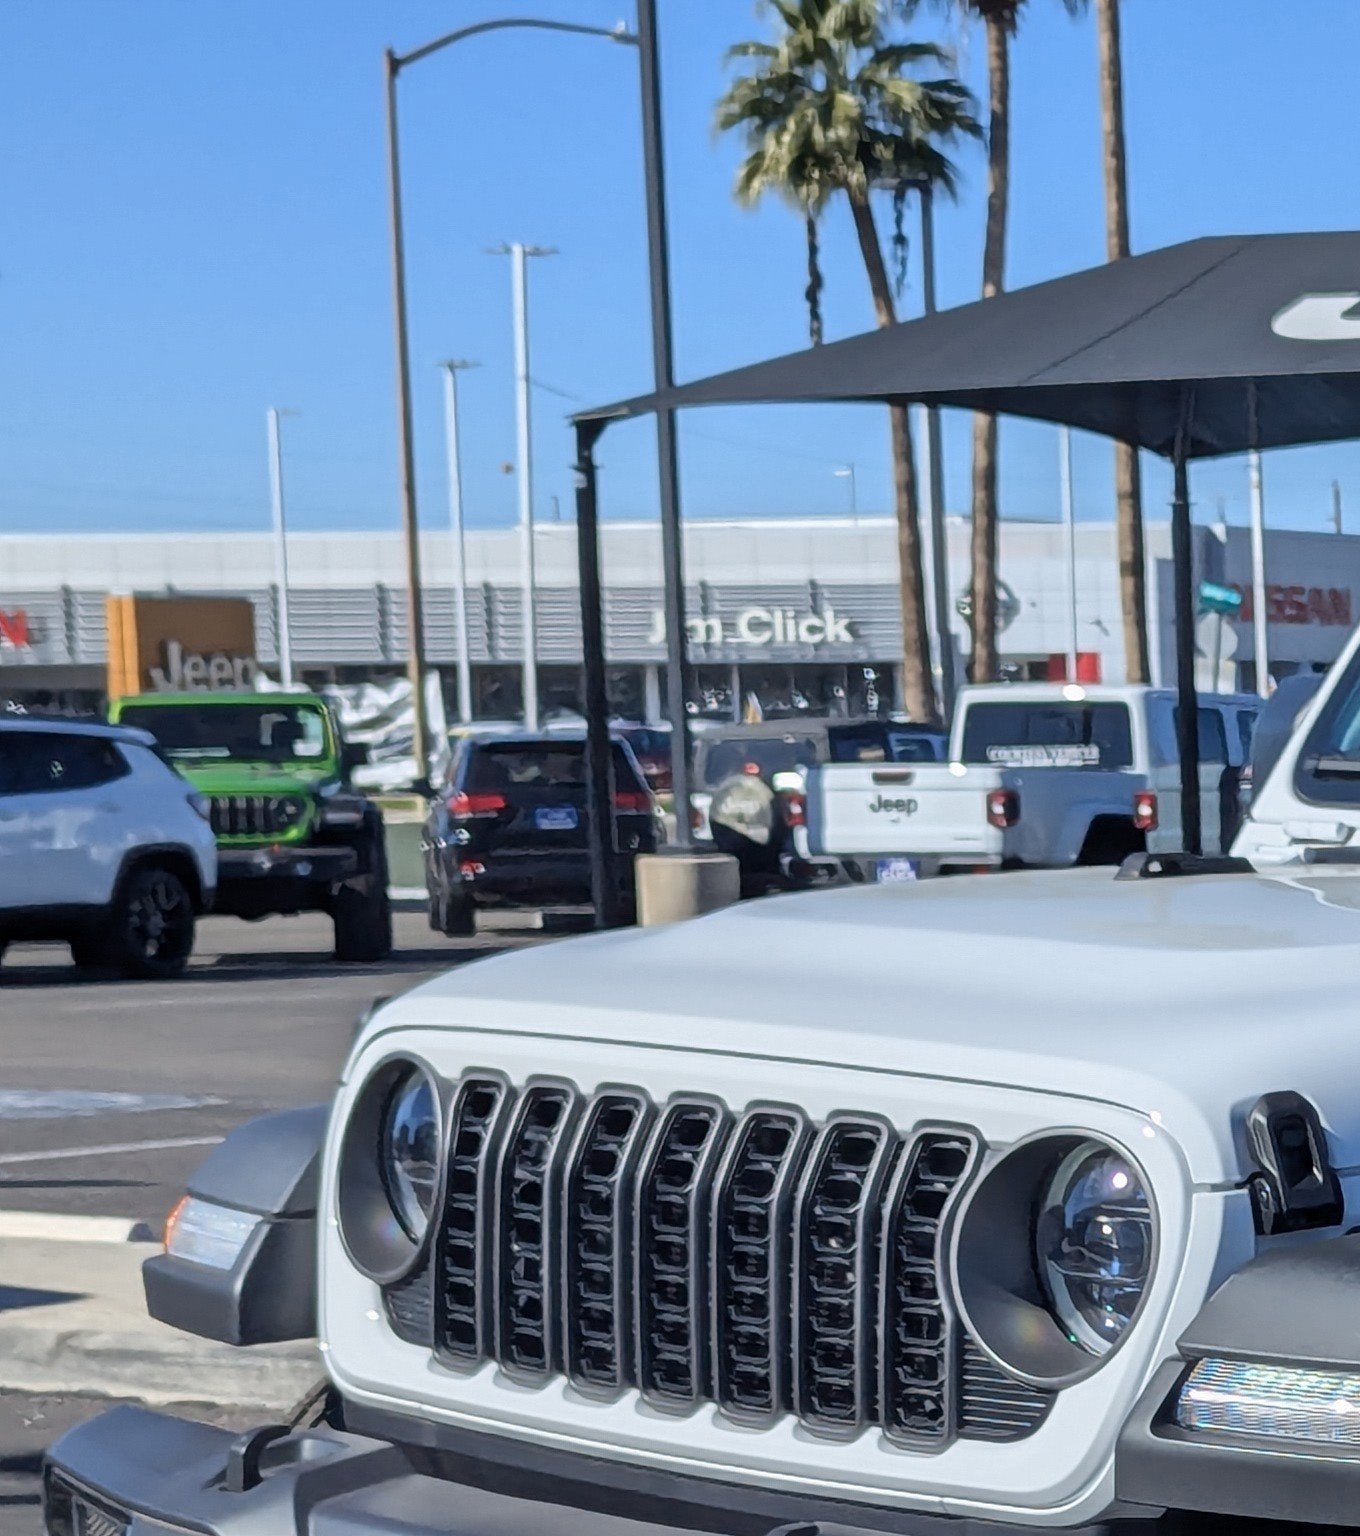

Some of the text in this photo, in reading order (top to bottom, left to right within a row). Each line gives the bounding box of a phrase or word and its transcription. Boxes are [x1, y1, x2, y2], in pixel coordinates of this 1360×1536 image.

[648, 606, 854, 645] Jm Click
[869, 794, 918, 817] Jeep
